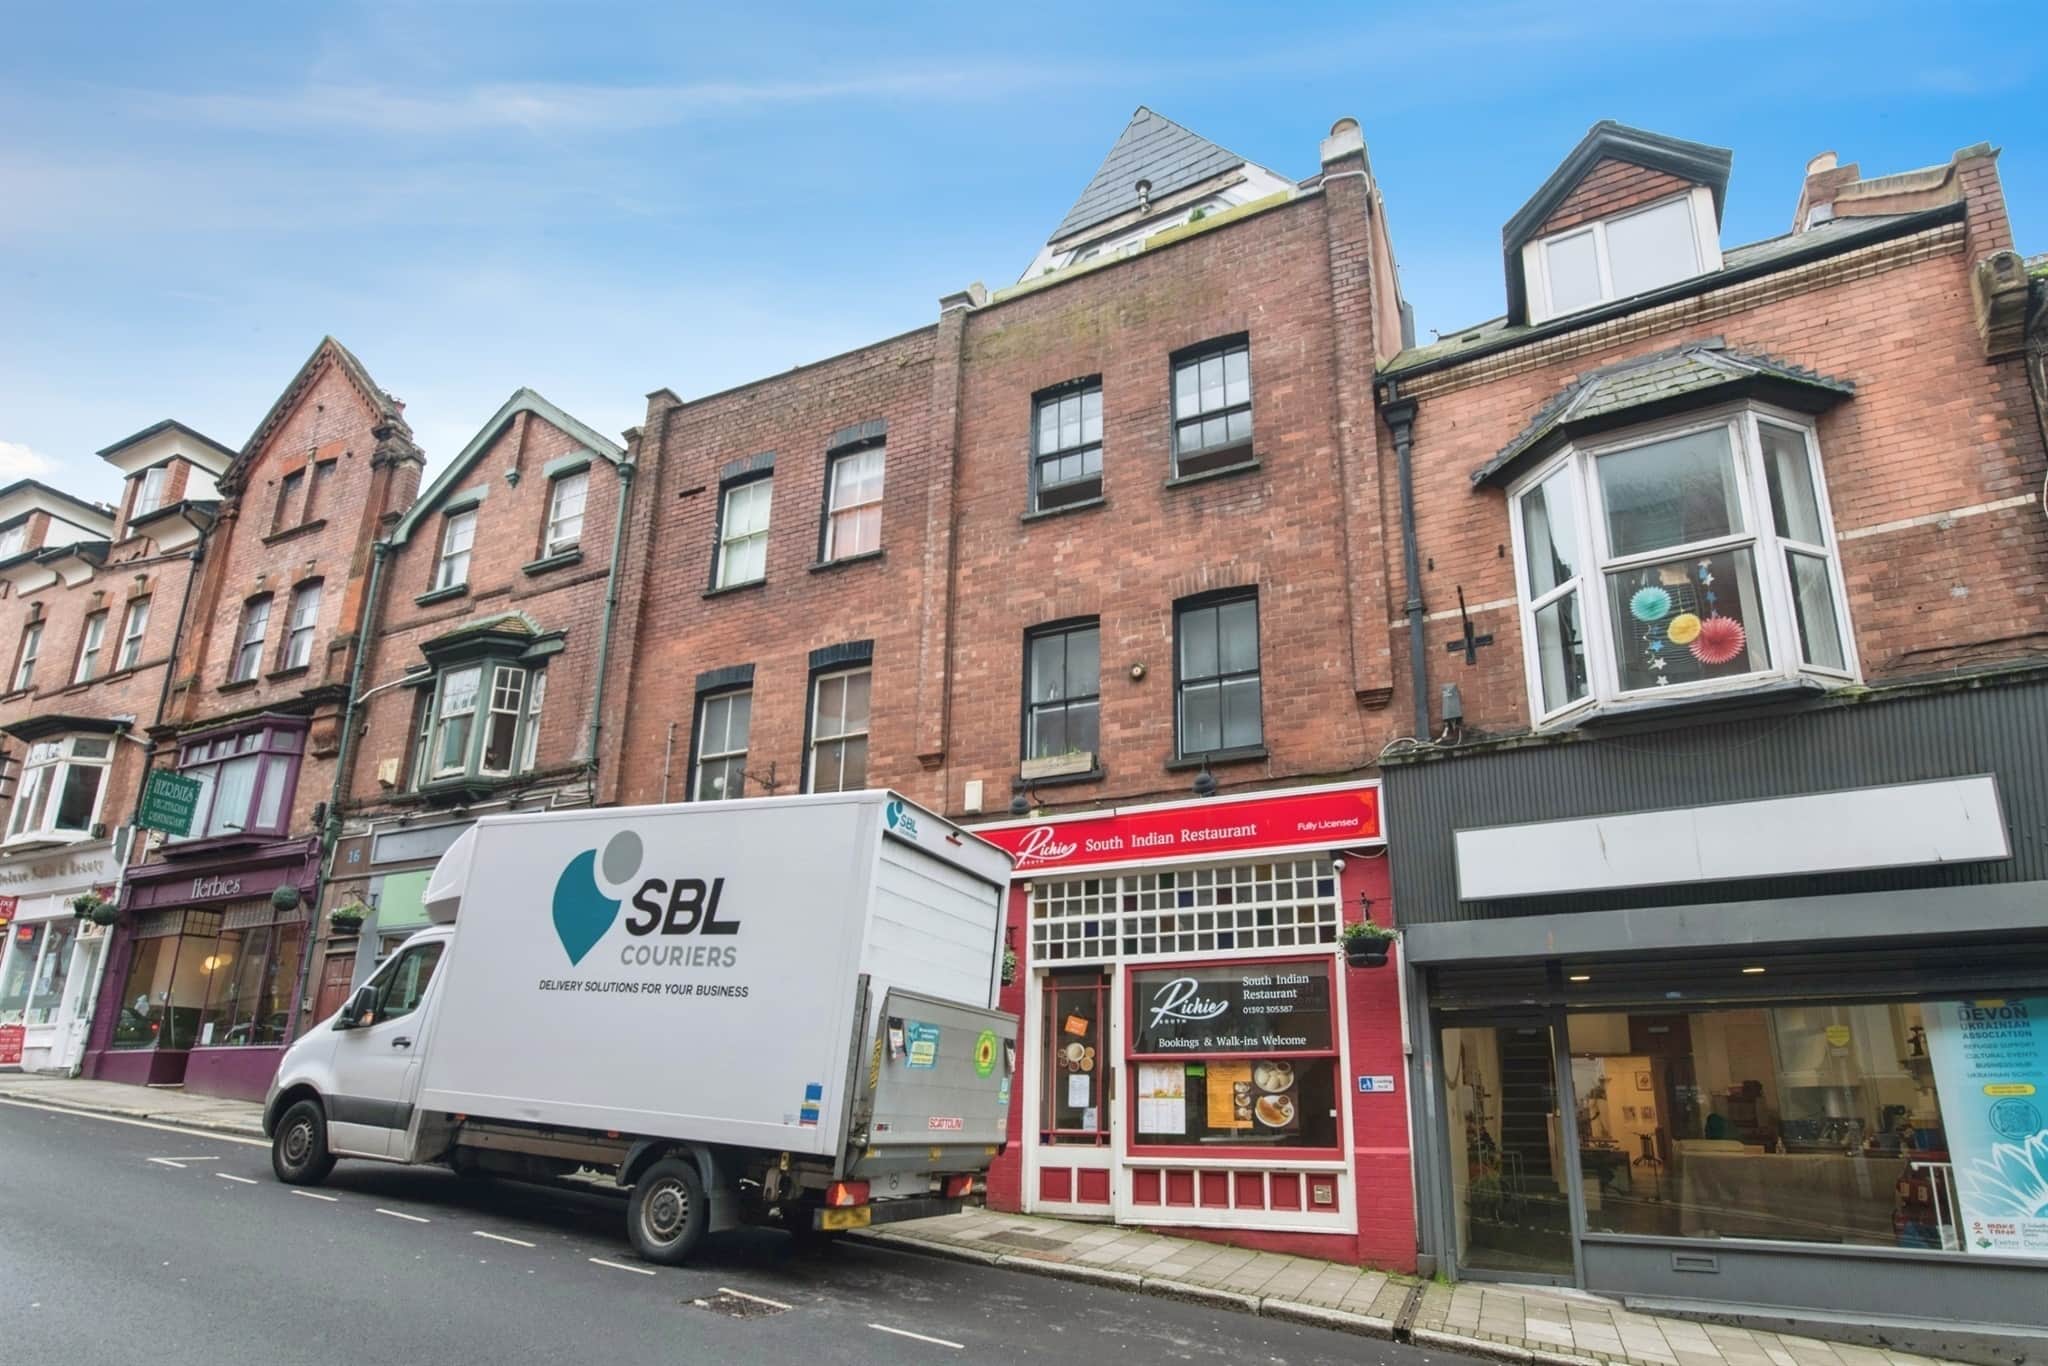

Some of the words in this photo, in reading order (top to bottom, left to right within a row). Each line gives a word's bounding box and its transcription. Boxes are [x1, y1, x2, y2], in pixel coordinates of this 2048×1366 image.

[899, 814, 918, 834] SBL
[1297, 821, 1317, 831] Fully
[1318, 817, 1359, 829] Licensed
[1085, 836, 1123, 852] South
[1131, 832, 1174, 848] Indian
[1180, 824, 1257, 843] Restaurant
[1016, 826, 1078, 869] Richie
[191, 875, 241, 899] Herbies
[625, 877, 741, 936] SBL
[620, 945, 737, 968] COURIERS
[539, 980, 583, 992] DELIVERY
[584, 981, 640, 994] SOLUTIONS
[641, 983, 661, 994] FOR
[665, 984, 693, 996] YOUR
[695, 985, 749, 998] BUSINESS
[1242, 975, 1272, 986] South
[1276, 974, 1309, 985] Indian
[1150, 977, 1229, 1029] Richie
[1243, 989, 1297, 1000] Restaurant
[1958, 1006, 2029, 1021] DEVON
[1960, 1020, 2031, 1031] UKRAINIAN
[1159, 1037, 1199, 1049] Bookings
[1204, 1038, 1212, 1047] &
[1216, 1036, 1258, 1047] Walk-ins
[1262, 1035, 1307, 1046] Welcome
[1962, 1030, 2032, 1040] ASSOCIATION
